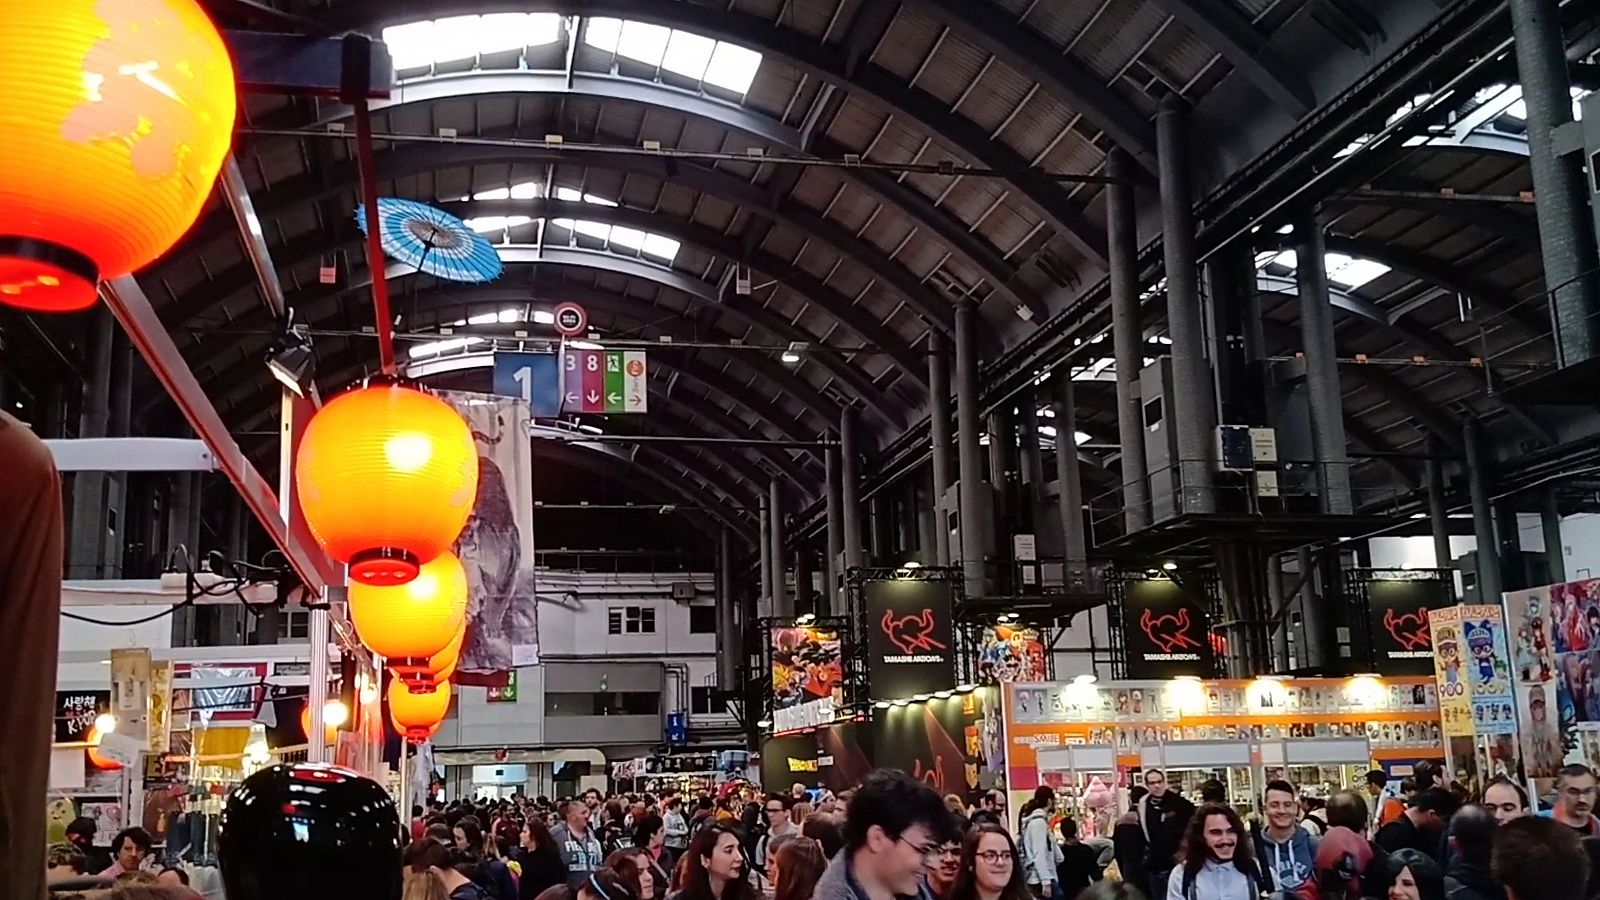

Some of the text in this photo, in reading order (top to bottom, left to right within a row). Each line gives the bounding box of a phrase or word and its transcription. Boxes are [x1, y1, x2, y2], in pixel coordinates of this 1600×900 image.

[565, 354, 599, 371] 3 8
[513, 366, 532, 402] 1
